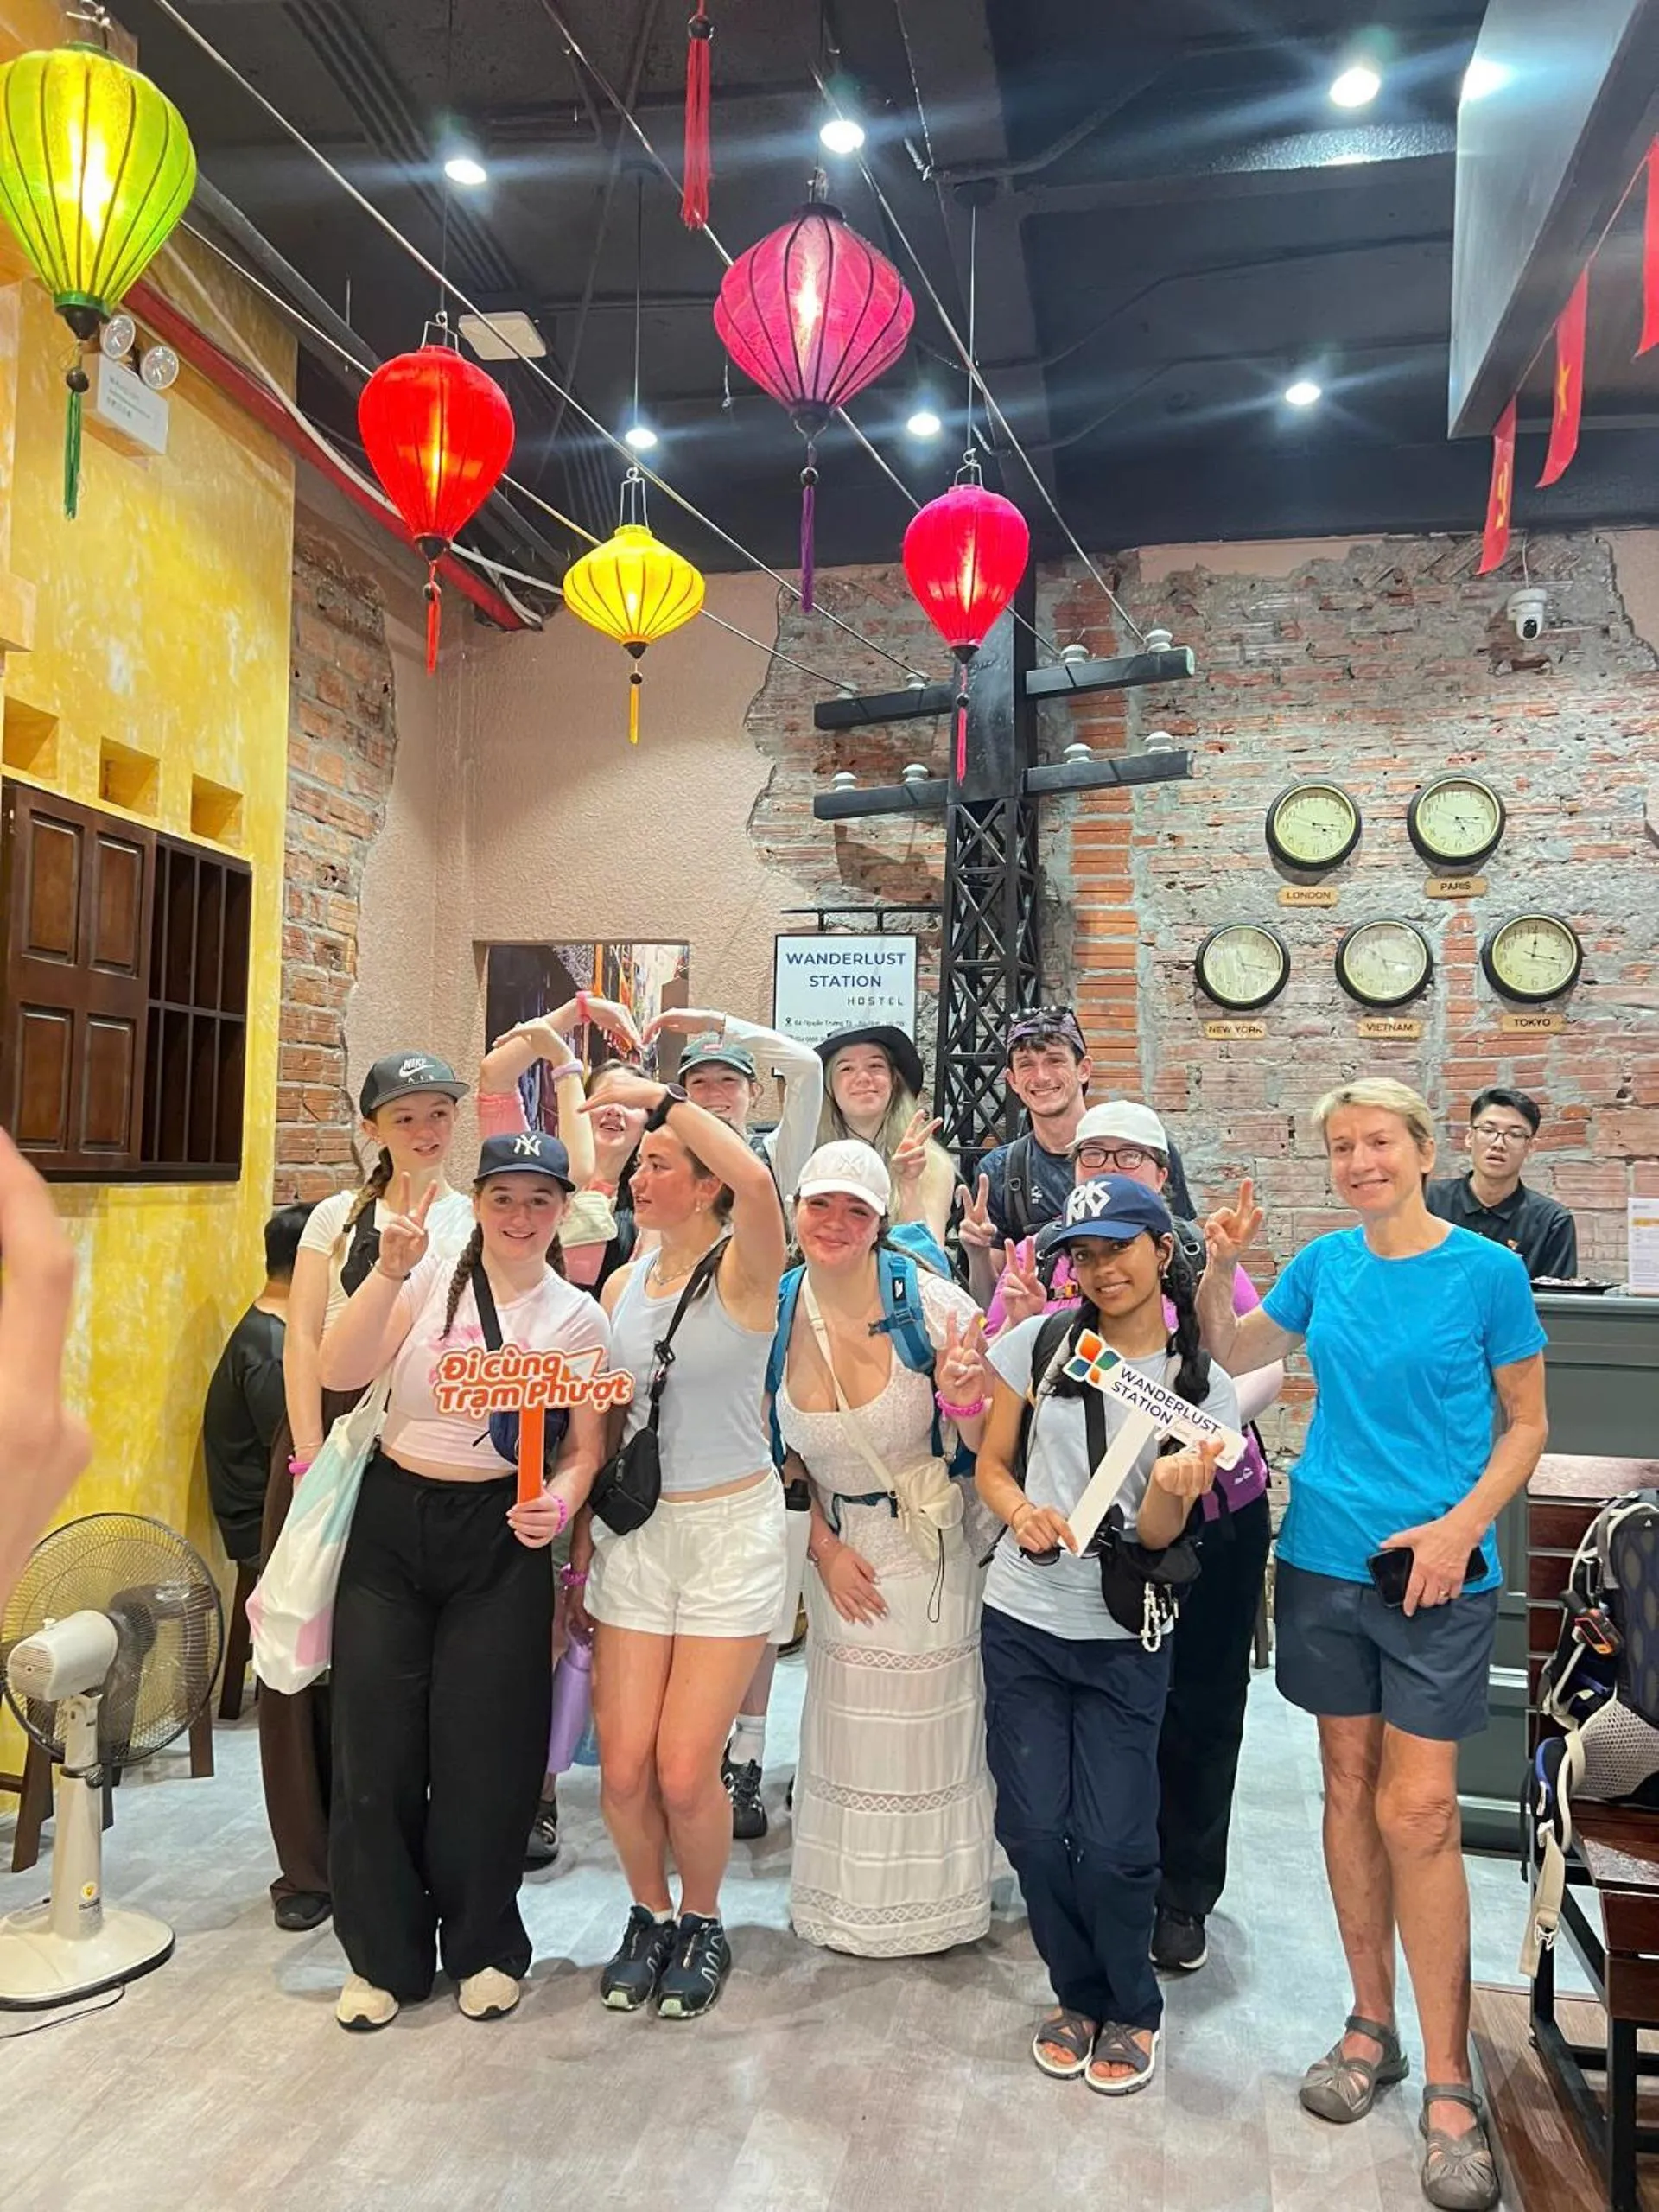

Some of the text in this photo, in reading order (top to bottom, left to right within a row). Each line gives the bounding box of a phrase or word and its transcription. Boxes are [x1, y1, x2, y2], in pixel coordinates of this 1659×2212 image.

[1440, 881, 1471, 891] PARIS
[1286, 891, 1331, 899] LONDON
[785, 952, 906, 965] WANDERLUST
[809, 975, 881, 988] STATION
[847, 996, 905, 1006] HOSTEL
[1208, 1026, 1262, 1034] NEW YORK
[1366, 1023, 1414, 1032] VIETNAM
[404, 1057, 427, 1070] NIKE
[442, 1350, 563, 1382] Đi cùng
[439, 1376, 632, 1416] Trạm Phượt
[1121, 1368, 1222, 1435] WANDERLUST
[1111, 1381, 1173, 1425] STATION
